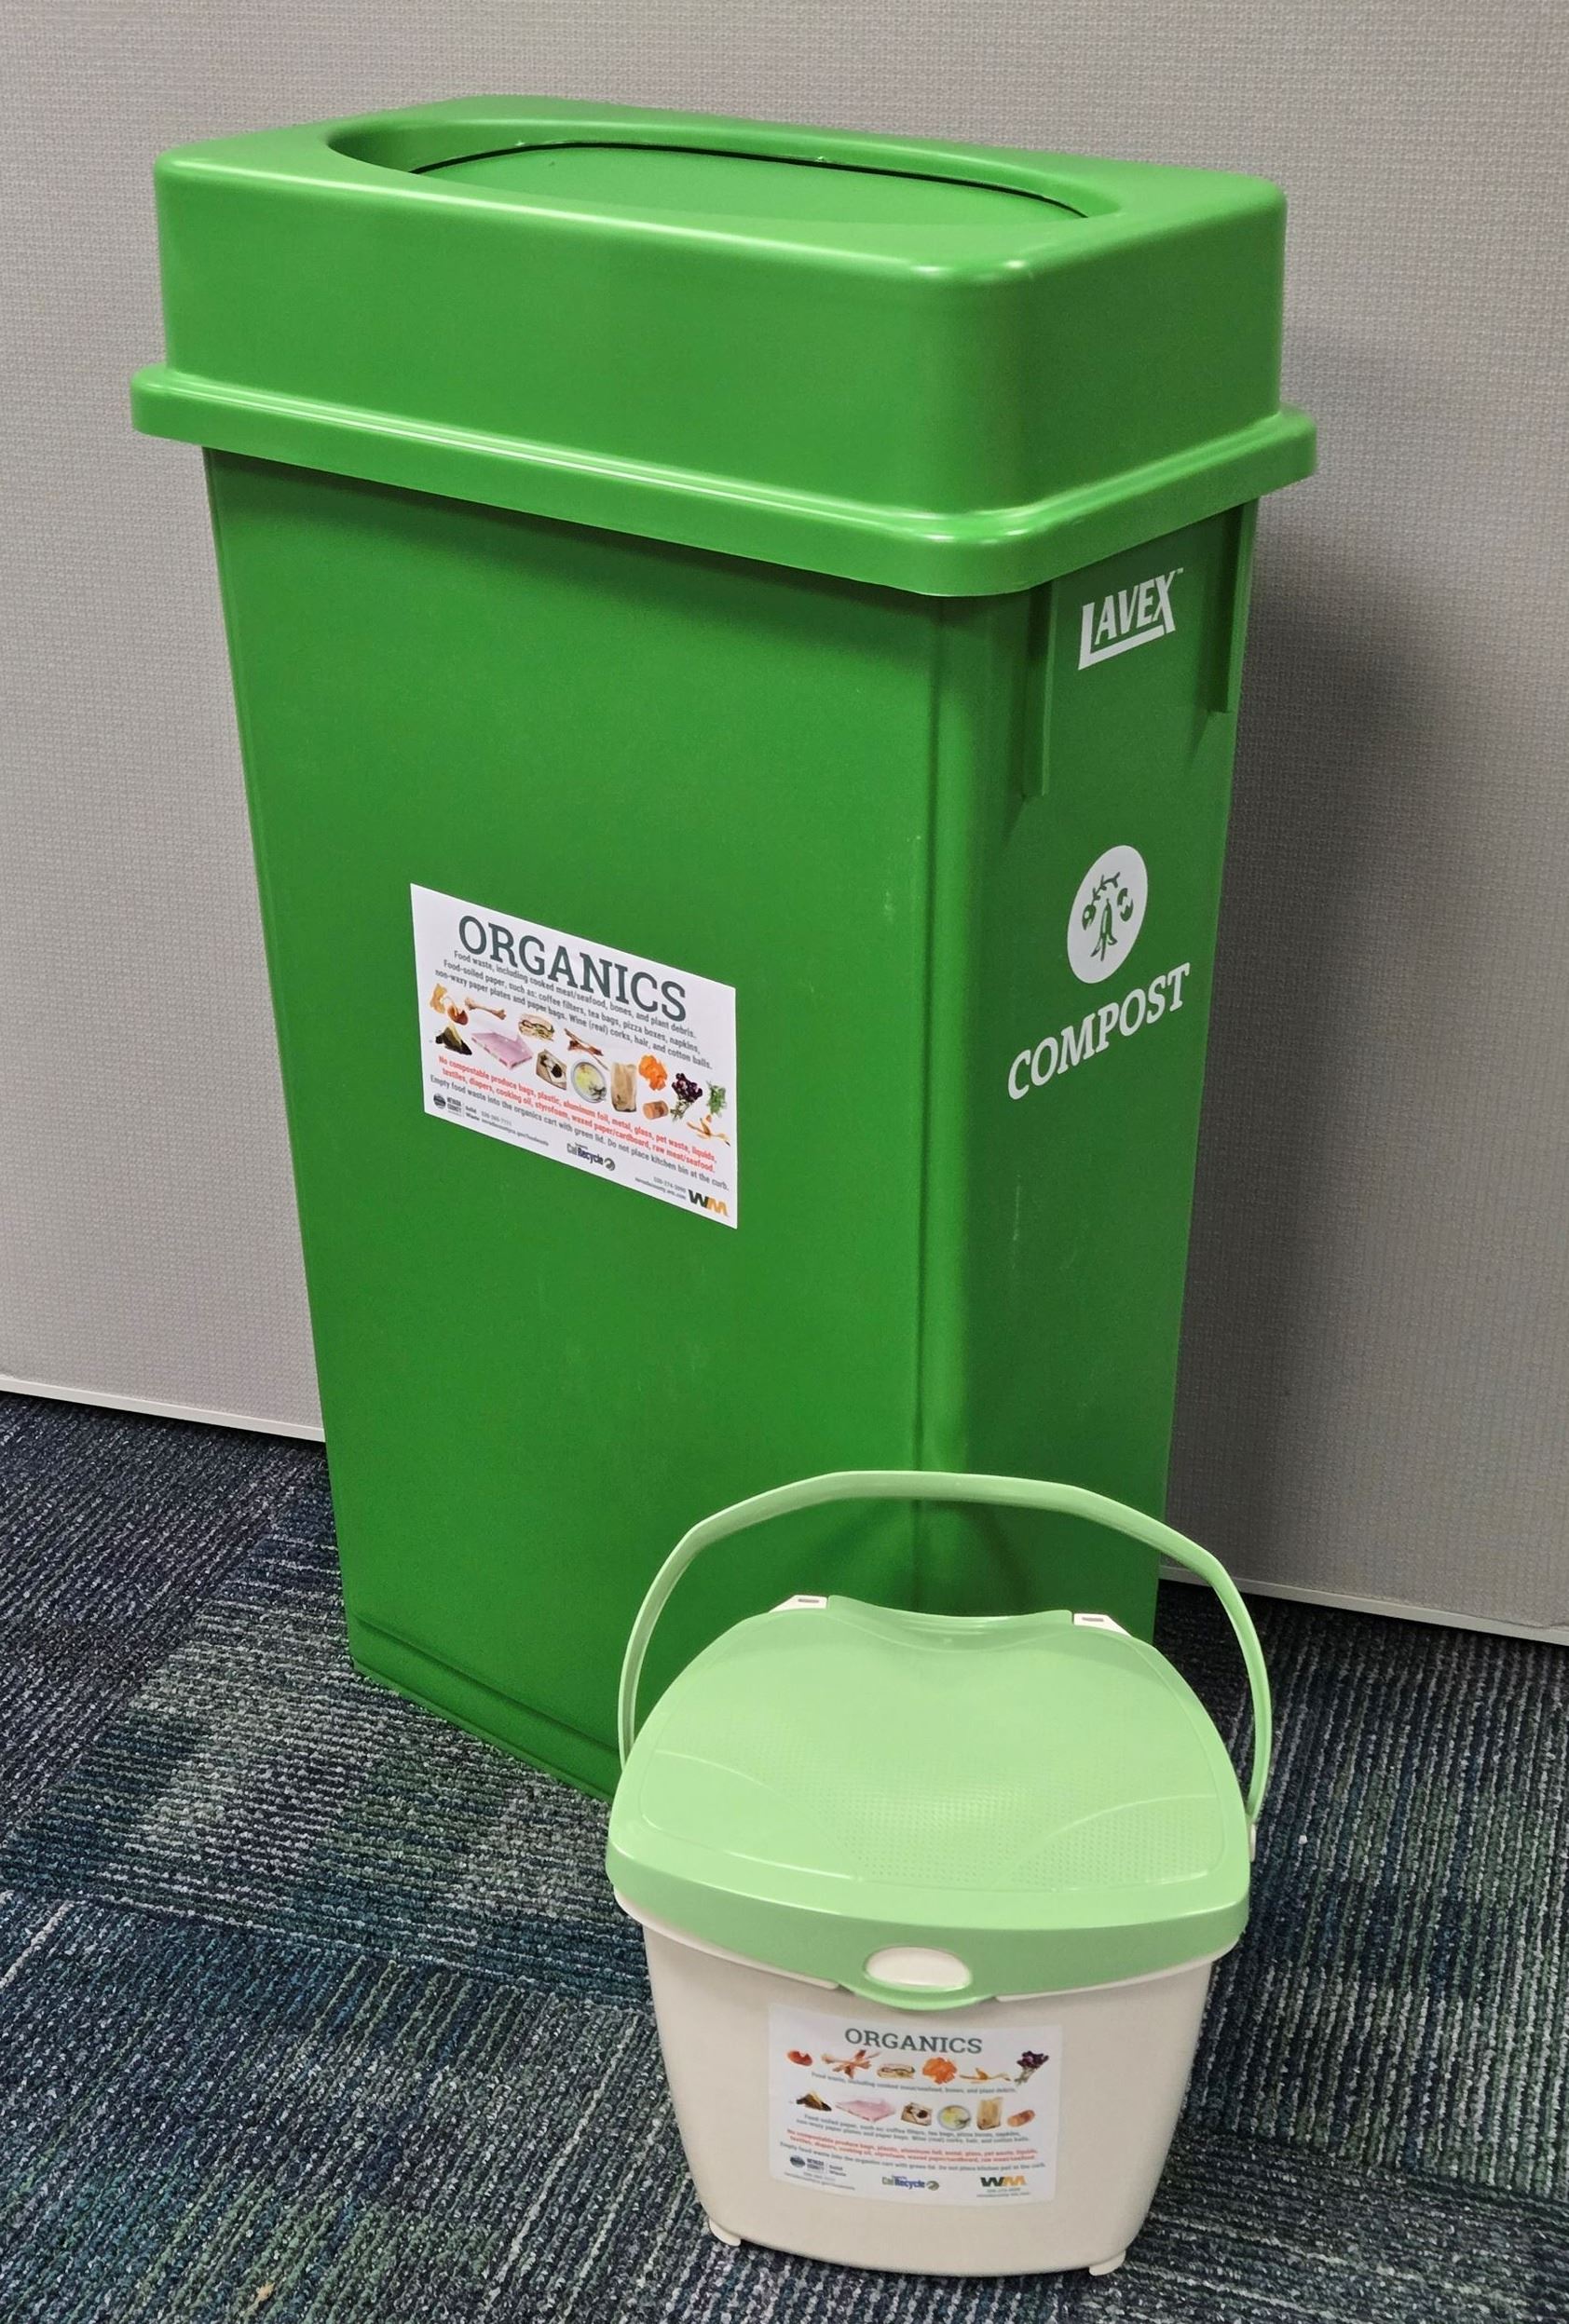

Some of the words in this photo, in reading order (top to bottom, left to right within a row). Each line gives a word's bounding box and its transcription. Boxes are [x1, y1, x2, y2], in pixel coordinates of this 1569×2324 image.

[443, 959, 483, 980] Food-soiled
[485, 975, 506, 989] paper,
[509, 983, 524, 994] such
[527, 989, 536, 998] as:
[538, 993, 559, 1006] coffee
[562, 999, 586, 1016] filters,
[588, 1007, 598, 1018] tea
[601, 1012, 621, 1028] bags,
[623, 1021, 641, 1033] pizza
[644, 1026, 667, 1043] boxes,
[669, 1037, 700, 1054] napkins,
[454, 949, 470, 962] Food
[472, 957, 494, 972] waste,
[496, 964, 527, 983] including
[529, 977, 553, 990] cooked
[556, 986, 607, 1010] meat/seafood,
[610, 1002, 633, 1018] bones,
[636, 1012, 648, 1022] and
[651, 1017, 668, 1029] plant
[671, 1022, 695, 1038] debris.
[458, 912, 685, 1024] ORGANICS
[435, 969, 467, 987] non-waxy
[469, 981, 487, 992] paper
[490, 987, 510, 1000] plates
[513, 996, 524, 1005] and
[527, 1000, 546, 1012] paper
[548, 1006, 566, 1019] bags.
[569, 1013, 586, 1026] Wine
[589, 1020, 607, 1035] (real)
[610, 1029, 632, 1043] corks,
[634, 1035, 650, 1049] hair,
[652, 1043, 665, 1053] and
[668, 1048, 690, 1061] cotton
[692, 1055, 712, 1069] balls.
[1008, 962, 1191, 1100] COMPOST
[430, 1074, 449, 1090] Empty
[451, 1081, 465, 1094] food
[467, 1089, 485, 1101] waste
[487, 1095, 499, 1106] into
[502, 1100, 512, 1111] the
[514, 1106, 541, 1121] organics
[544, 1117, 557, 1127] cart
[559, 1122, 572, 1133] with
[574, 1128, 592, 1140] green
[595, 1134, 605, 1145] lid.
[607, 1138, 616, 1149] Do
[618, 1144, 628, 1154] not
[631, 1148, 648, 1161] place
[651, 1154, 675, 1171] kitchen
[678, 1164, 688, 1175] bin
[690, 1170, 696, 1178] at
[699, 1172, 709, 1183] the
[712, 1178, 729, 1190] curb.
[688, 1189, 727, 1216] WM
[845, 2026, 982, 2053] ORGANICS
[980, 2175, 1026, 2186] WM
